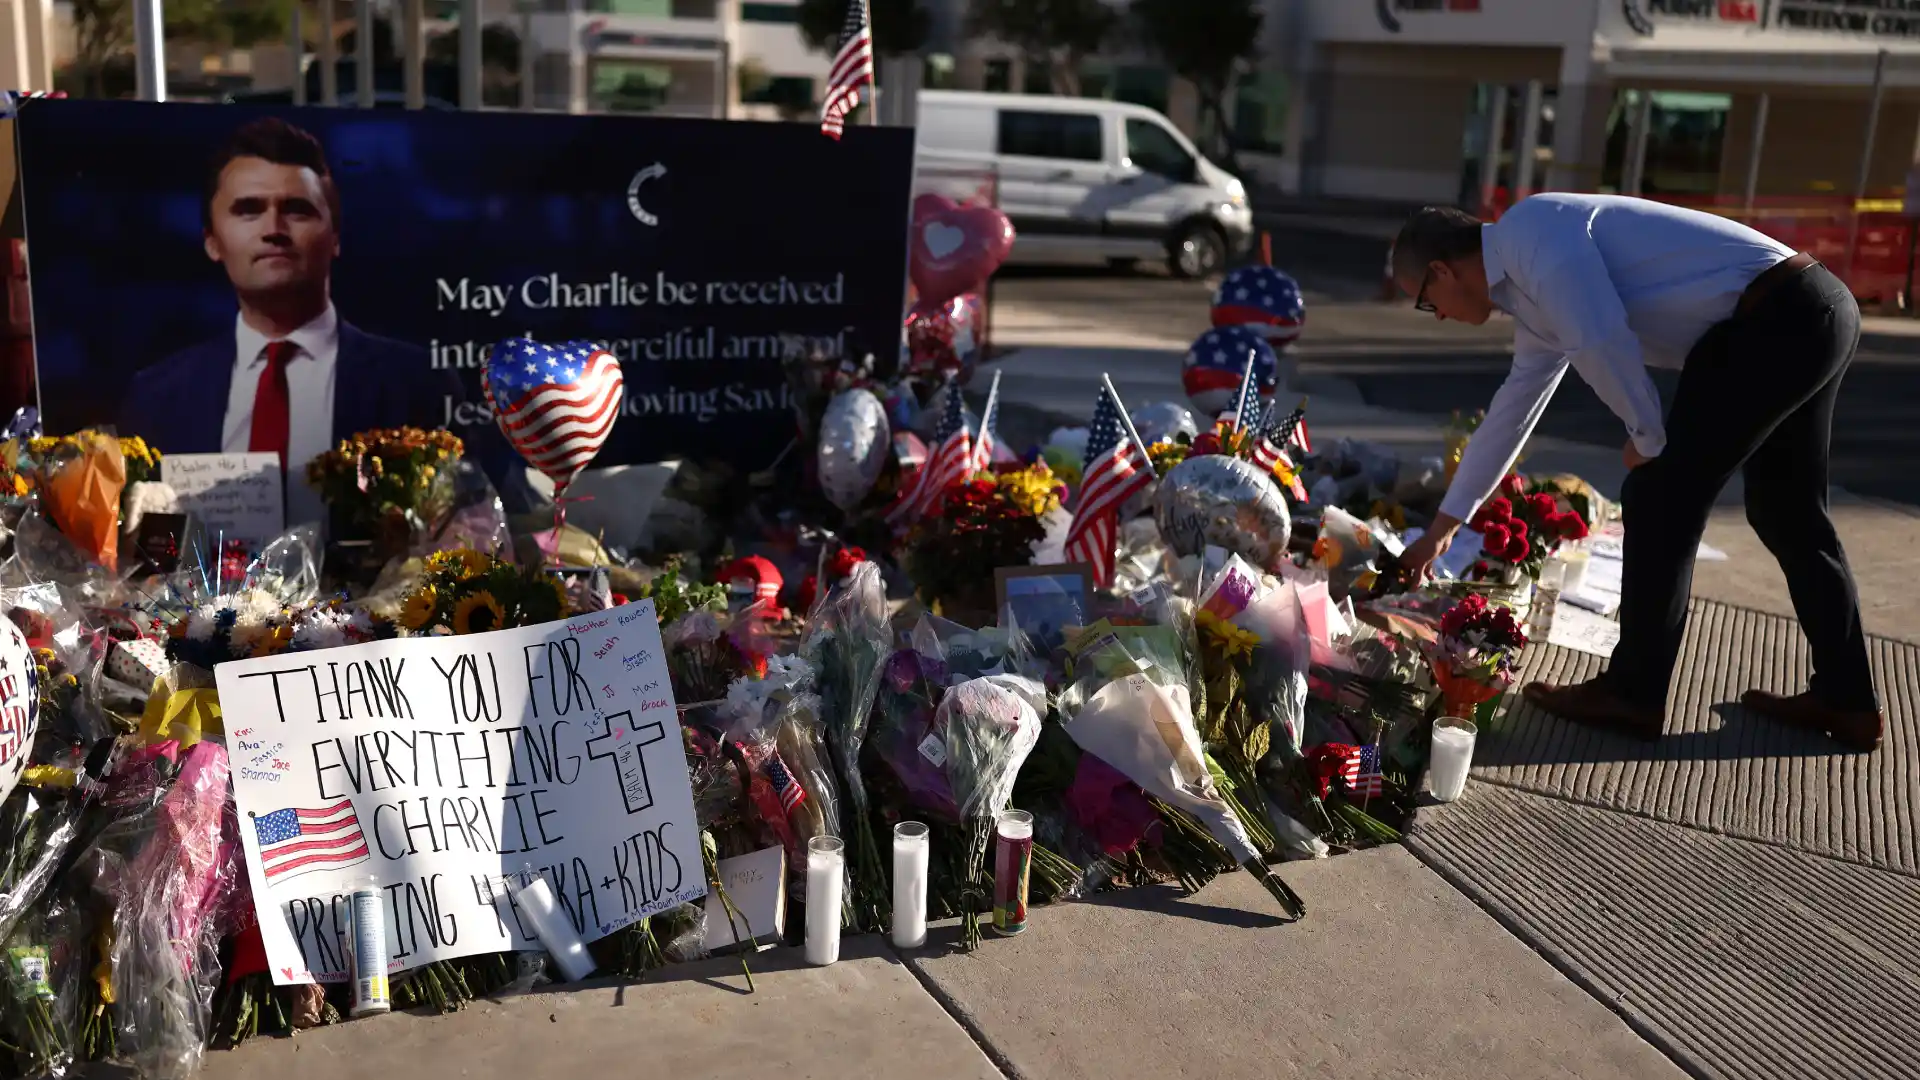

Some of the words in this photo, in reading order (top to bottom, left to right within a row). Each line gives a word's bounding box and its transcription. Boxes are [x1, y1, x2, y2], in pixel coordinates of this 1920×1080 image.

[436, 277, 514, 317] May
[521, 272, 650, 309] Charlie
[657, 271, 698, 305] be
[705, 271, 844, 304] received
[597, 326, 715, 362] erciful
[621, 381, 719, 422] loving
[567, 618, 609, 636] Heather
[238, 657, 414, 724] THANK
[431, 652, 502, 724] YOU
[523, 637, 596, 718] FOR
[632, 680, 659, 697] Max
[250, 742, 284, 767] Jessica
[311, 720, 581, 800] EVERYTHING
[240, 766, 281, 783] Shannon
[373, 789, 564, 861] CHARLIE
[674, 884, 705, 903] Family
[289, 873, 459, 975] PRAING
